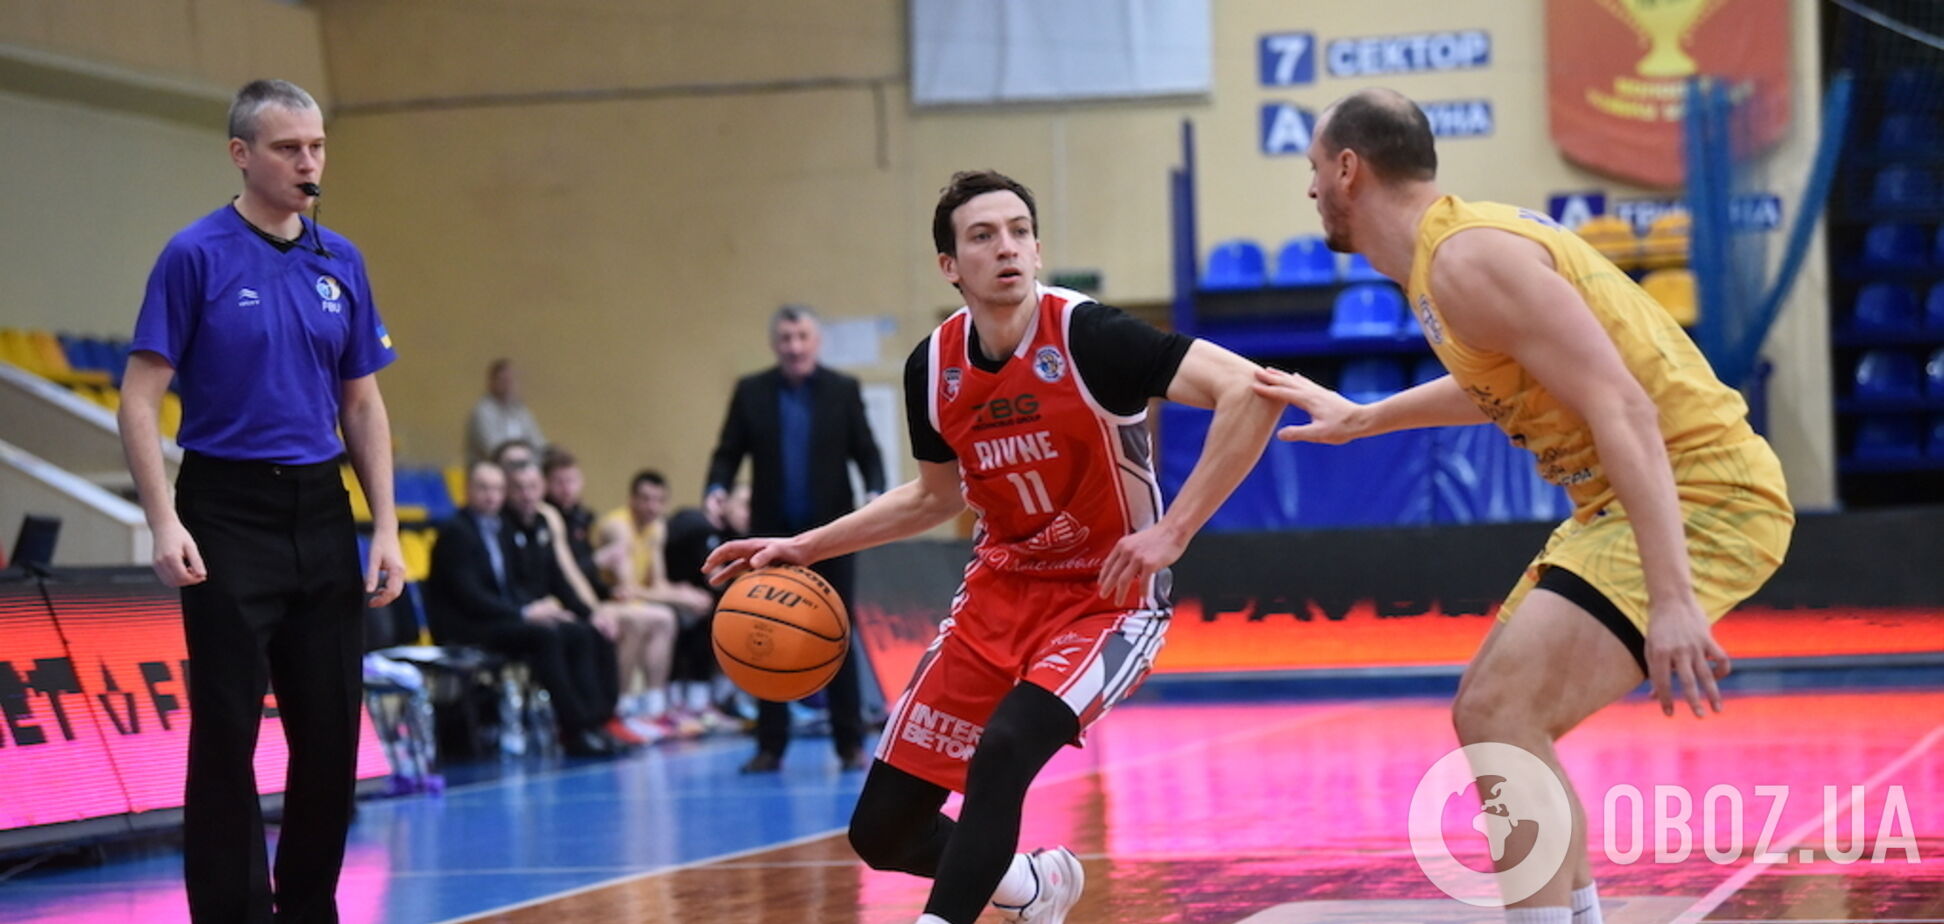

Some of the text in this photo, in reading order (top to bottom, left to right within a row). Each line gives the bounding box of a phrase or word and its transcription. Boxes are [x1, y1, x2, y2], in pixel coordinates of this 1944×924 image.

[1266, 32, 1488, 86] 7 СЕКТОР
[1266, 103, 1490, 154] А УНА
[973, 430, 1059, 471] RIVNE
[1006, 470, 1054, 515] 11
[746, 584, 802, 608] EVO
[0, 657, 84, 748] ET
[909, 702, 985, 747] INTER
